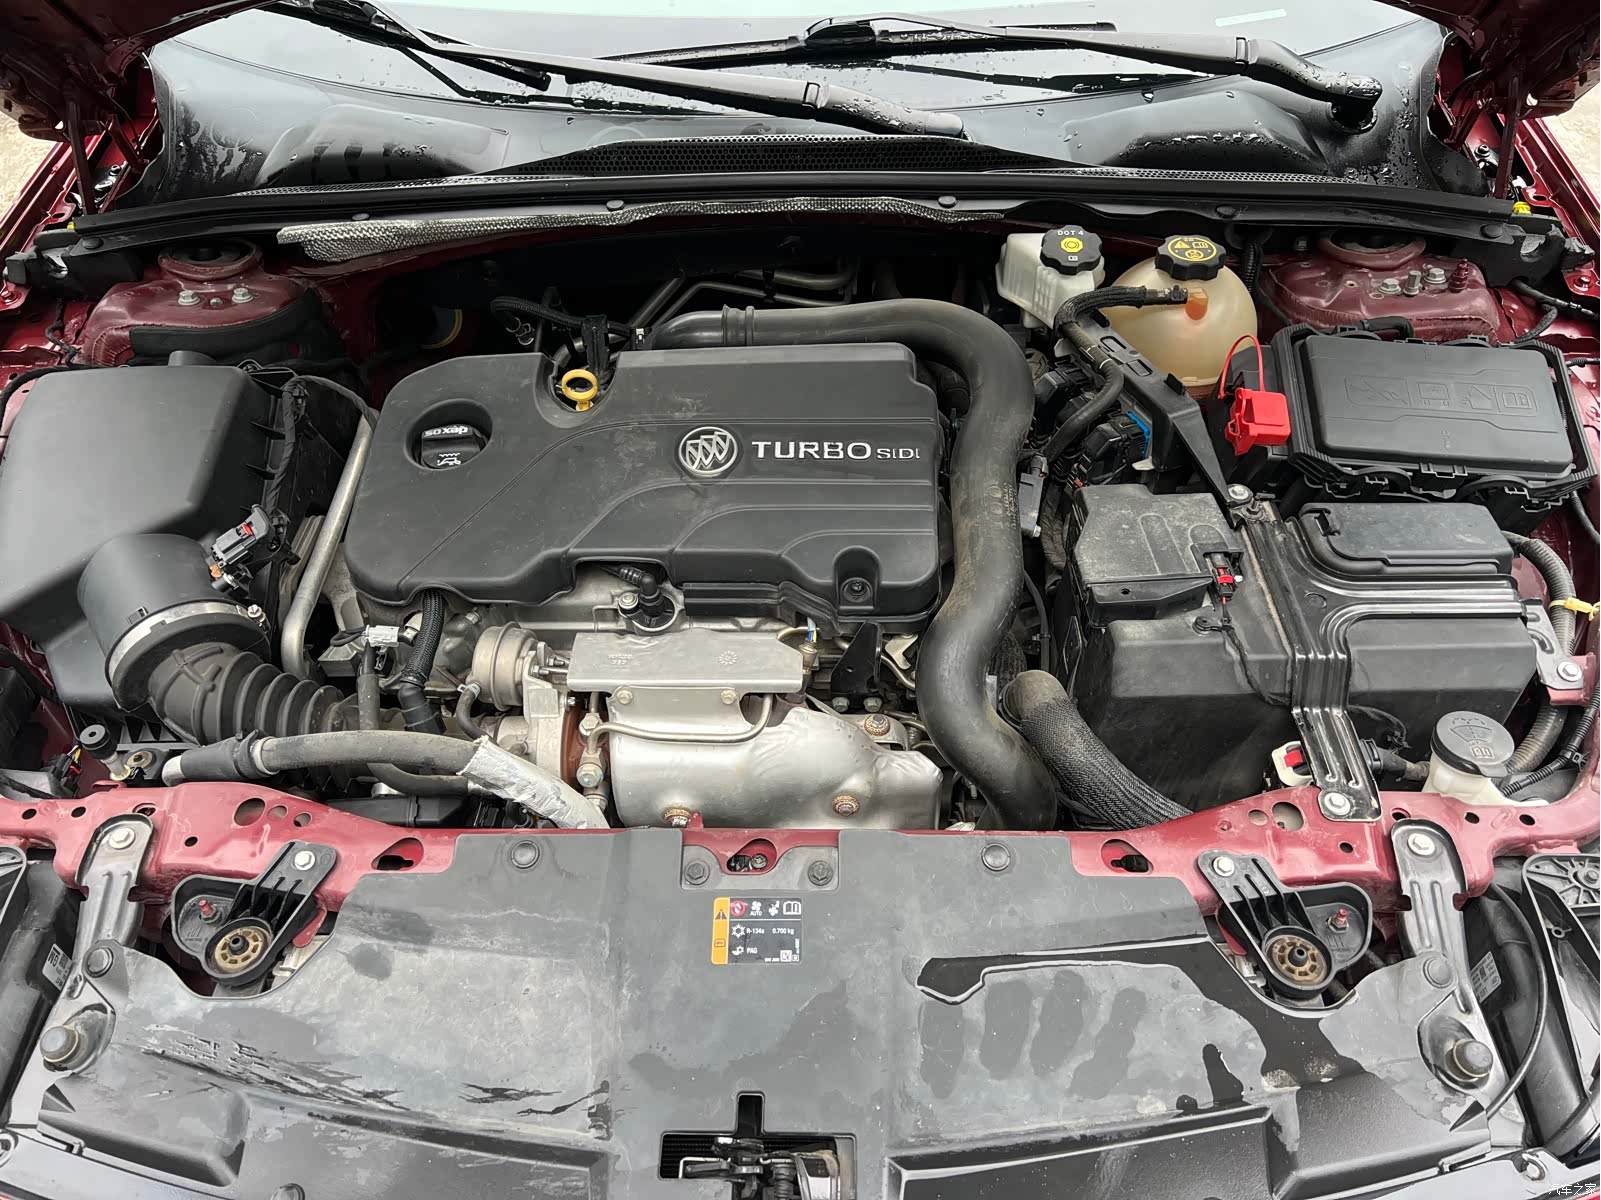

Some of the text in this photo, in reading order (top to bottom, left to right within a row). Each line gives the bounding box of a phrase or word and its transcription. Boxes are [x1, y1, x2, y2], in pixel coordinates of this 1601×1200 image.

[425, 425, 468, 437] dexos
[751, 441, 920, 460] TURBO SIDI
